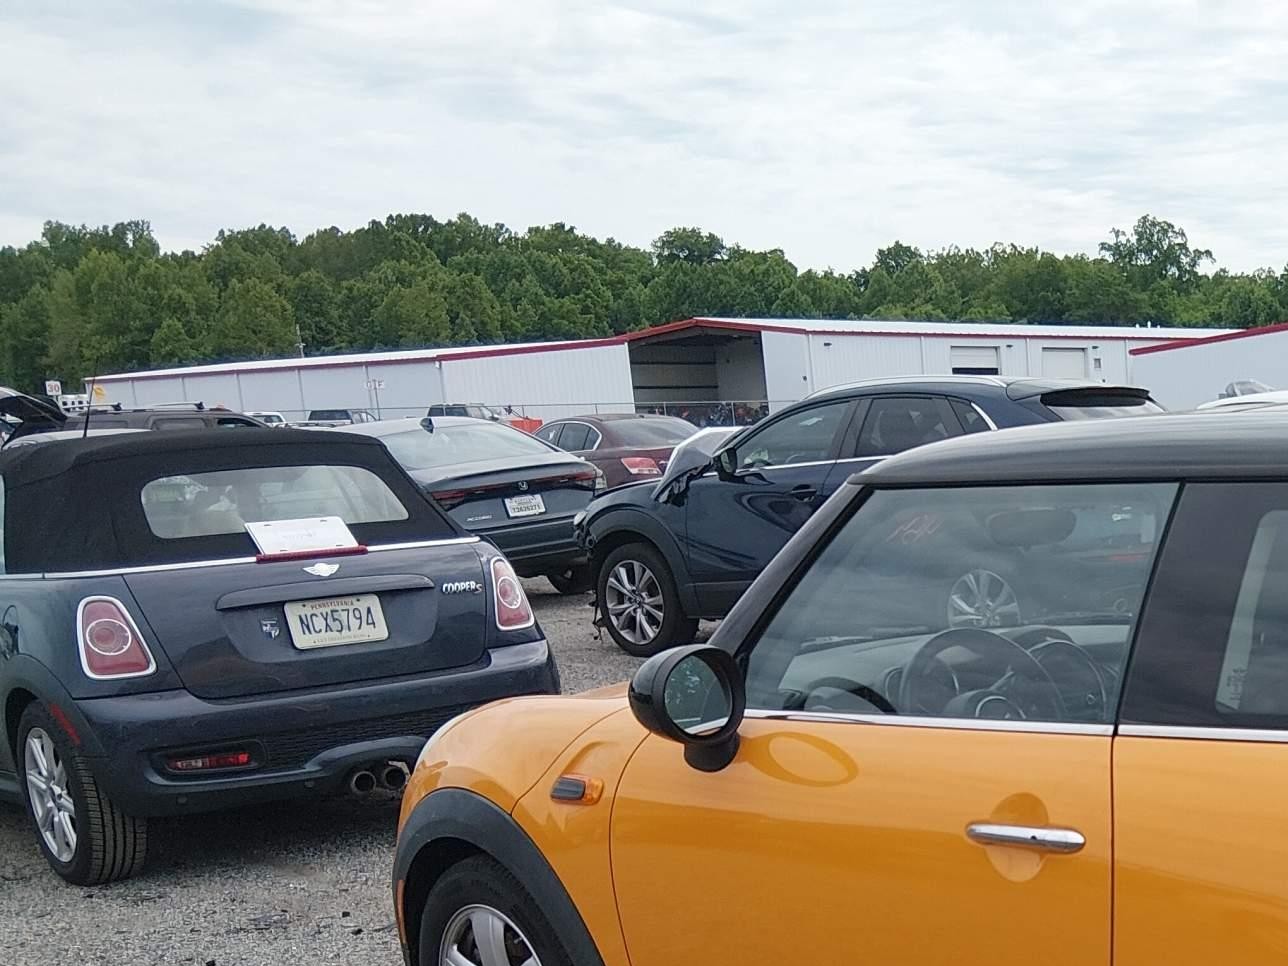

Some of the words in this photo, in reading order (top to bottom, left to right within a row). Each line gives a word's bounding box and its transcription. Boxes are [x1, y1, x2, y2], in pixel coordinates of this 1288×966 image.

[48, 383, 60, 393] 30
[310, 600, 354, 610] PENNSYLVANIA
[298, 606, 376, 635] NCX5794
